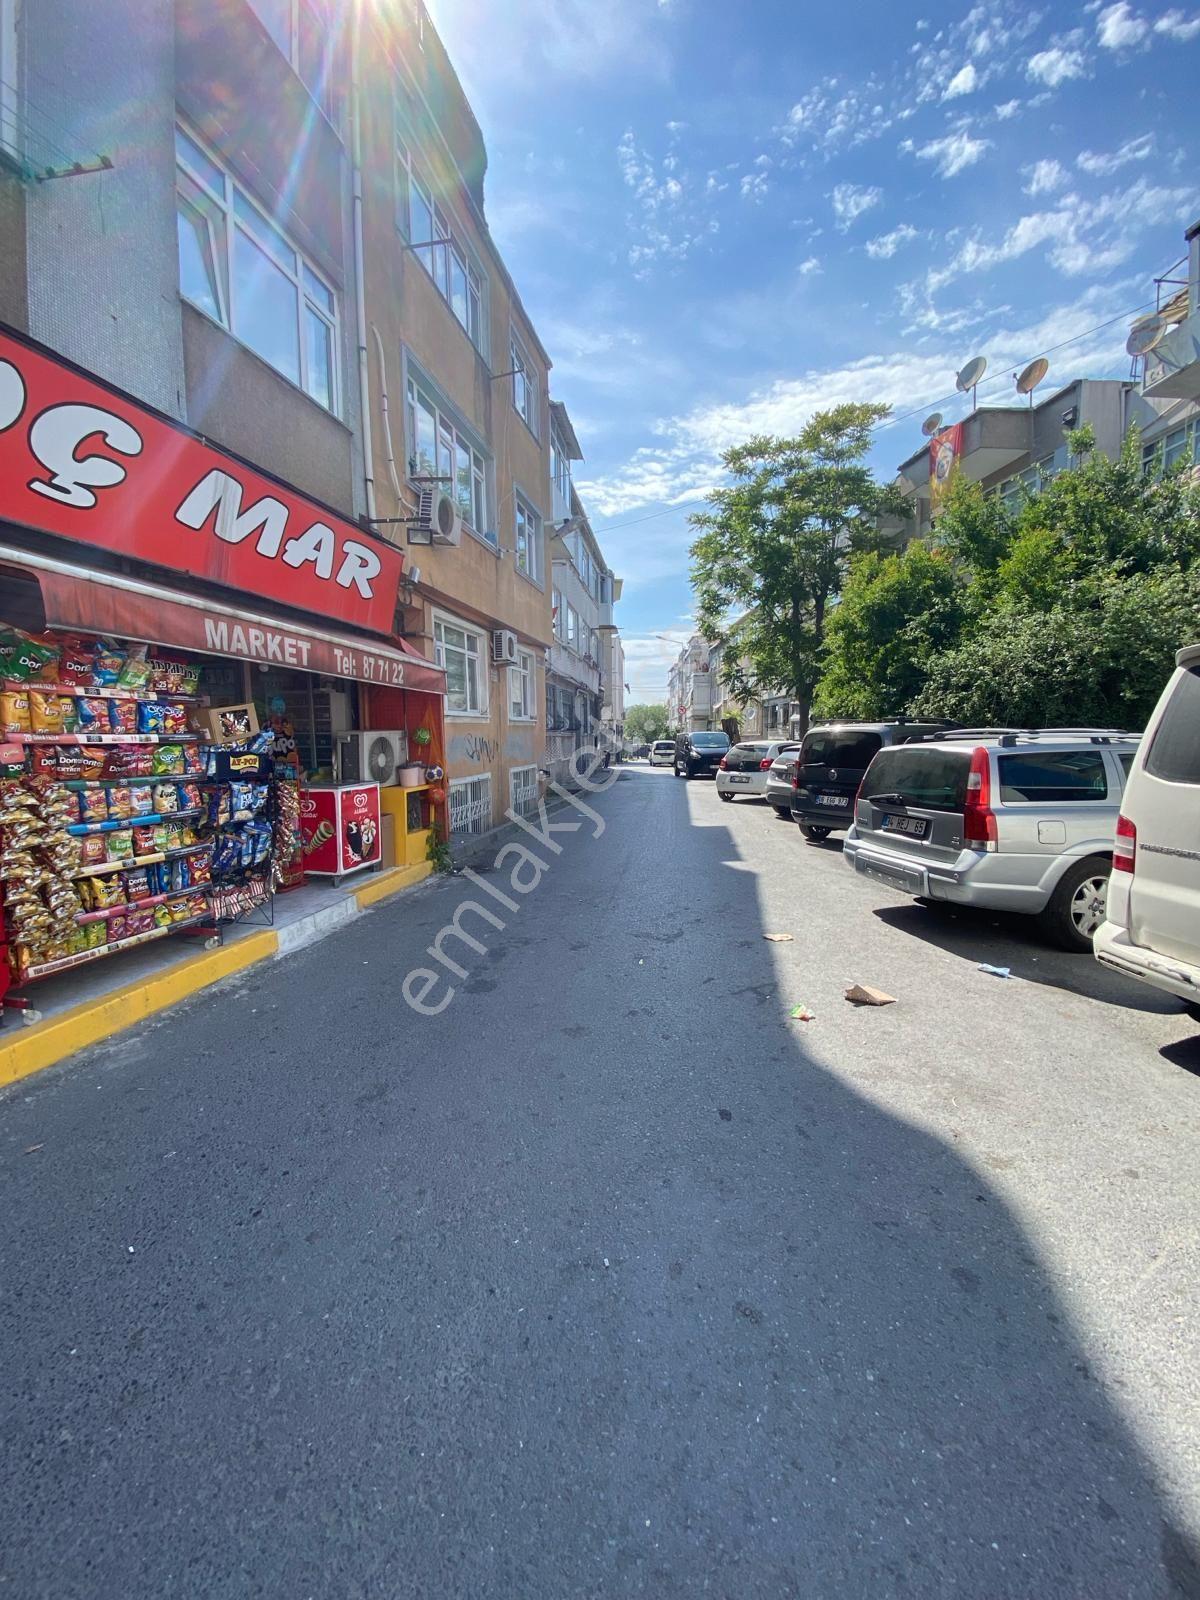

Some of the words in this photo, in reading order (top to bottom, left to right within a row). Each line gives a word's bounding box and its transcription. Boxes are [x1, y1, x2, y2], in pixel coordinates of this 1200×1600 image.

[174, 467, 381, 600] MAR
[204, 618, 312, 667] MARKET
[334, 649, 357, 677] Tel:
[362, 659, 376, 679] 87
[378, 663, 390, 681] 71
[391, 665, 404, 685] 22
[896, 817, 910, 831] HEJ
